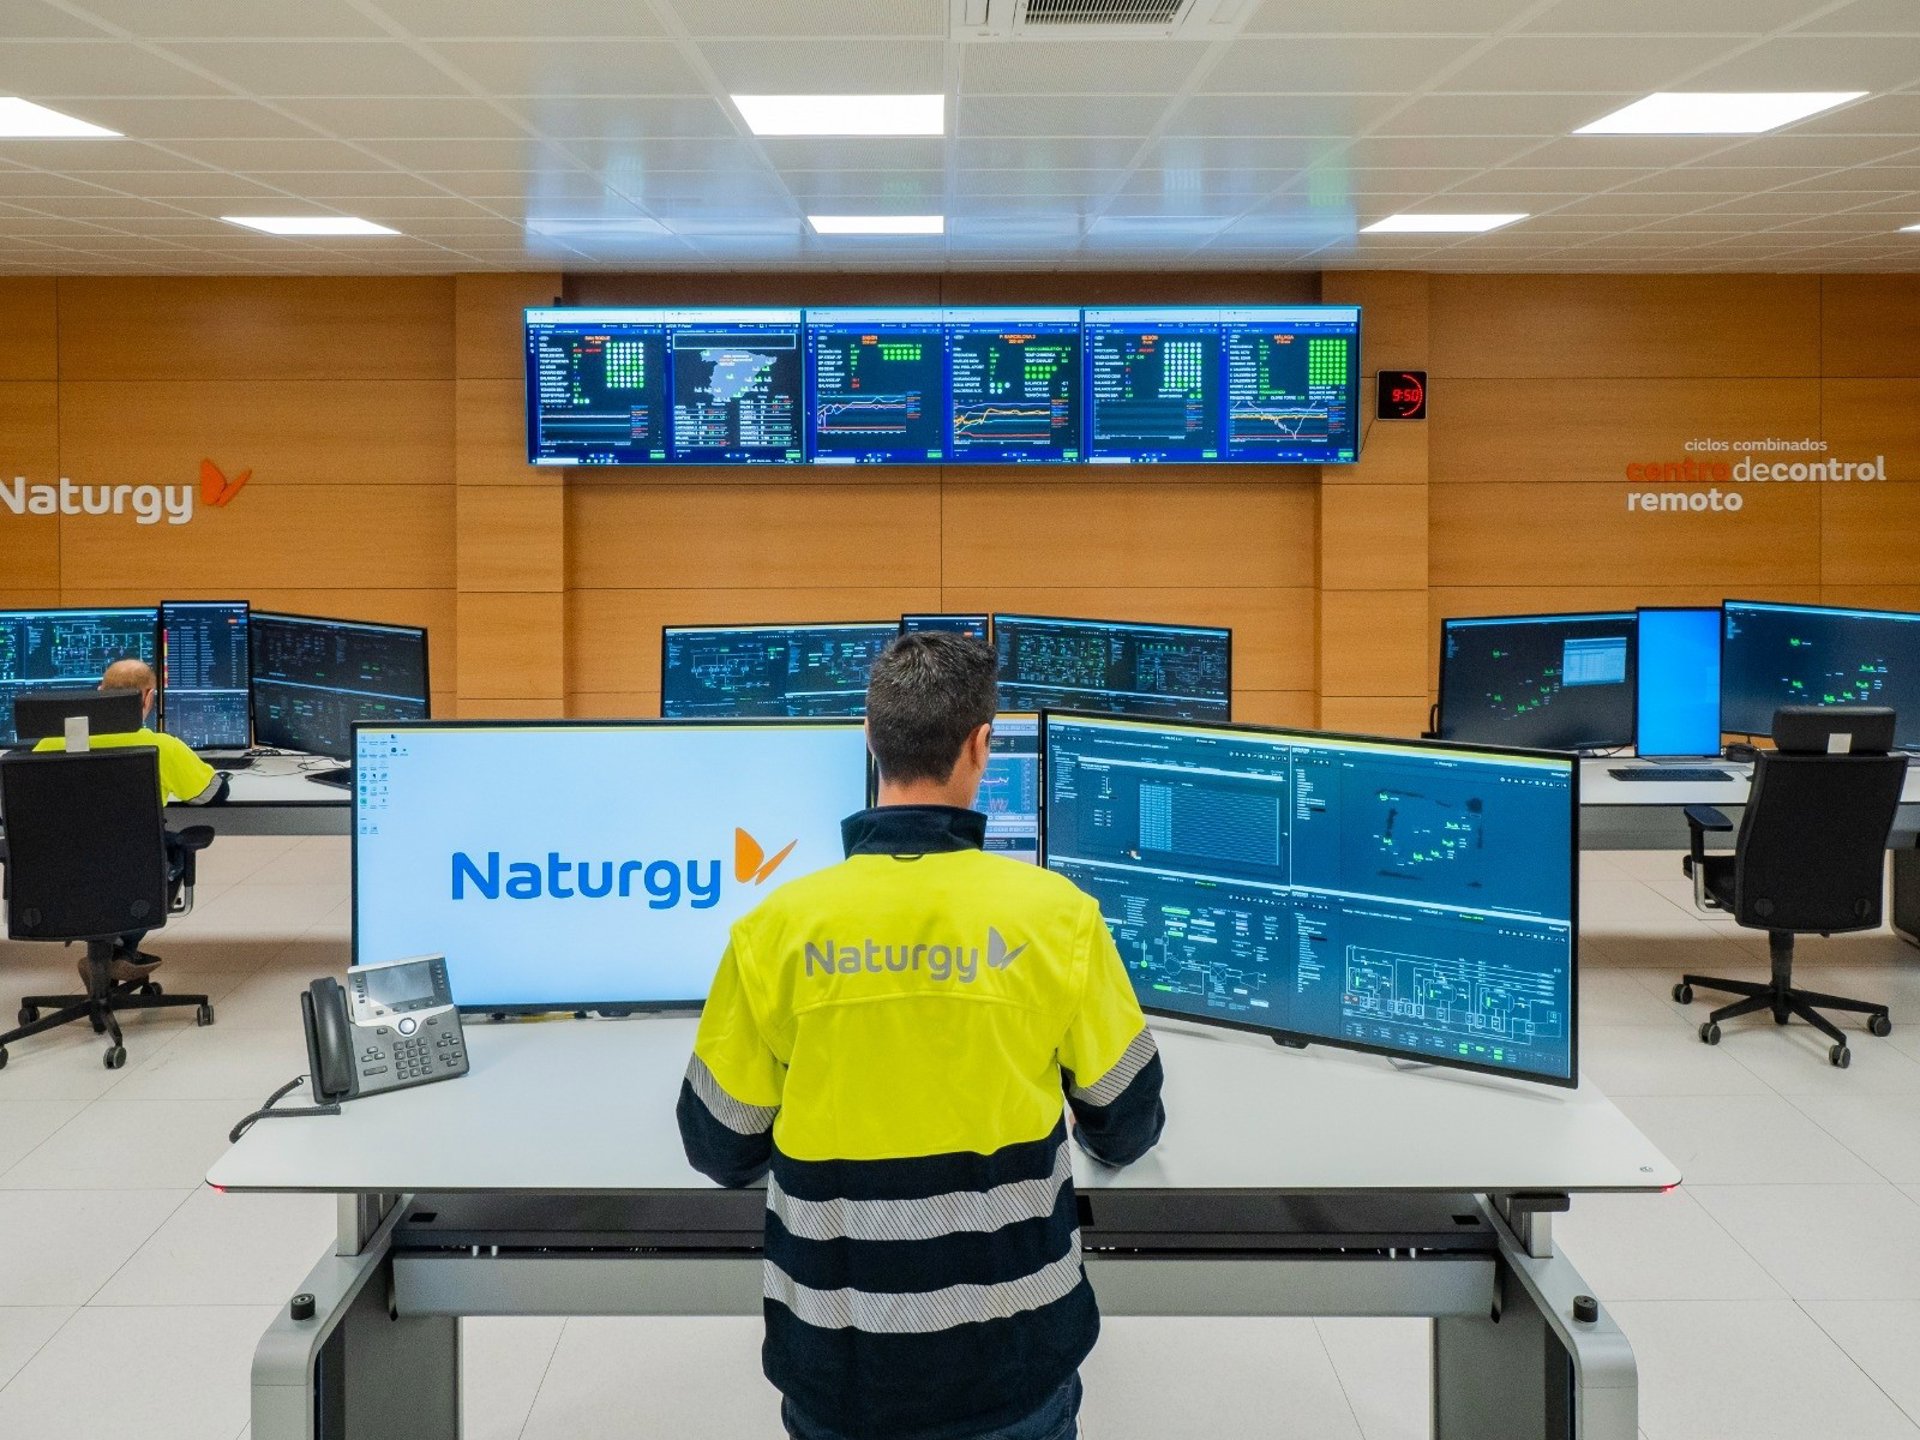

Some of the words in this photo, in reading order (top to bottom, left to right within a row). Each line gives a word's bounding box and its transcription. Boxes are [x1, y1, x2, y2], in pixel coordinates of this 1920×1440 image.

[1392, 388, 1418, 402] 9:50
[1684, 438, 1729, 451] ciclos
[1733, 438, 1828, 451] combinados
[0, 477, 193, 524] Naturgy
[1627, 488, 1743, 512] remoto
[452, 852, 721, 909] Naturgy
[804, 939, 979, 984] Naturgy
